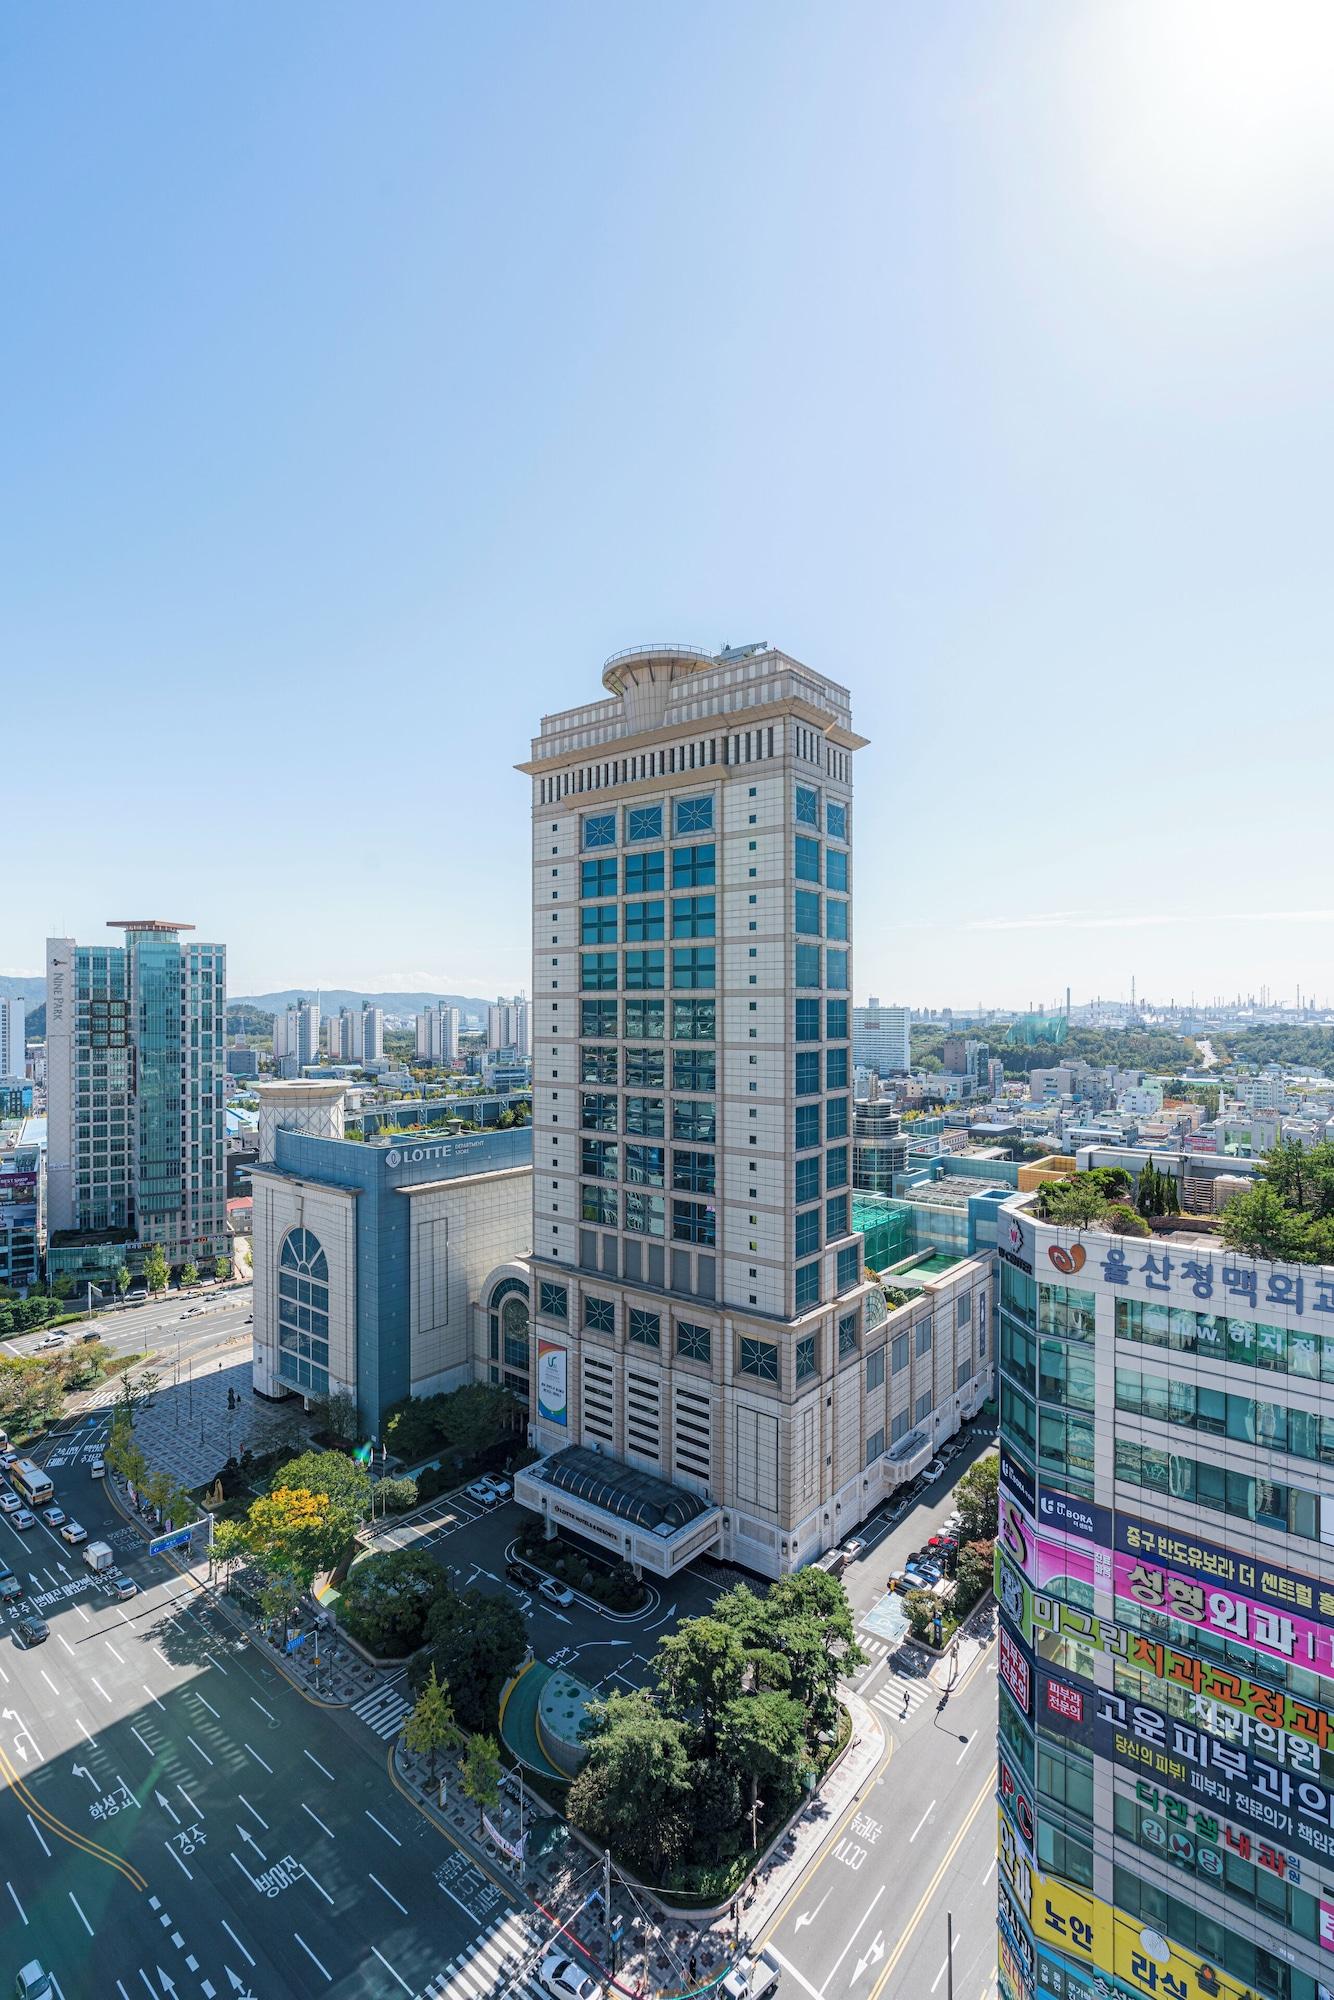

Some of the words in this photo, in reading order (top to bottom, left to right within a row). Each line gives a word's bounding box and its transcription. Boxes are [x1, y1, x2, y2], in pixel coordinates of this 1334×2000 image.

[53, 972, 65, 996] NINE
[53, 997, 65, 1021] PARK
[403, 1145, 452, 1163] LOTTE
[1127, 1525, 1156, 1552] 중구
[1157, 1535, 1236, 1582] 반도유보라
[1238, 1563, 1255, 1588] 더
[1260, 1571, 1313, 1609] 센트럴
[6, 1601, 31, 1619] 경주
[34, 1588, 65, 1607] 방어진
[1128, 1564, 1298, 1657] 성형외과
[1049, 1681, 1081, 1706] 피부과
[1049, 1693, 1081, 1720] 전문의
[1189, 1693, 1320, 1779] 치과의원
[1115, 1734, 1152, 1767] 당신의
[1155, 1753, 1186, 1783] 피부!
[1190, 1770, 1231, 1805] 피부과
[1235, 1792, 1293, 1836] 전문의가
[88, 1786, 134, 1821] 학성교
[173, 1823, 207, 1856] 경주
[831, 1837, 868, 1870] CCTV
[255, 1854, 305, 1899] 방어진
[449, 1868, 487, 1901] CCTV
[1045, 1899, 1093, 1953] 노안
[1132, 1950, 1187, 2000] 라식
